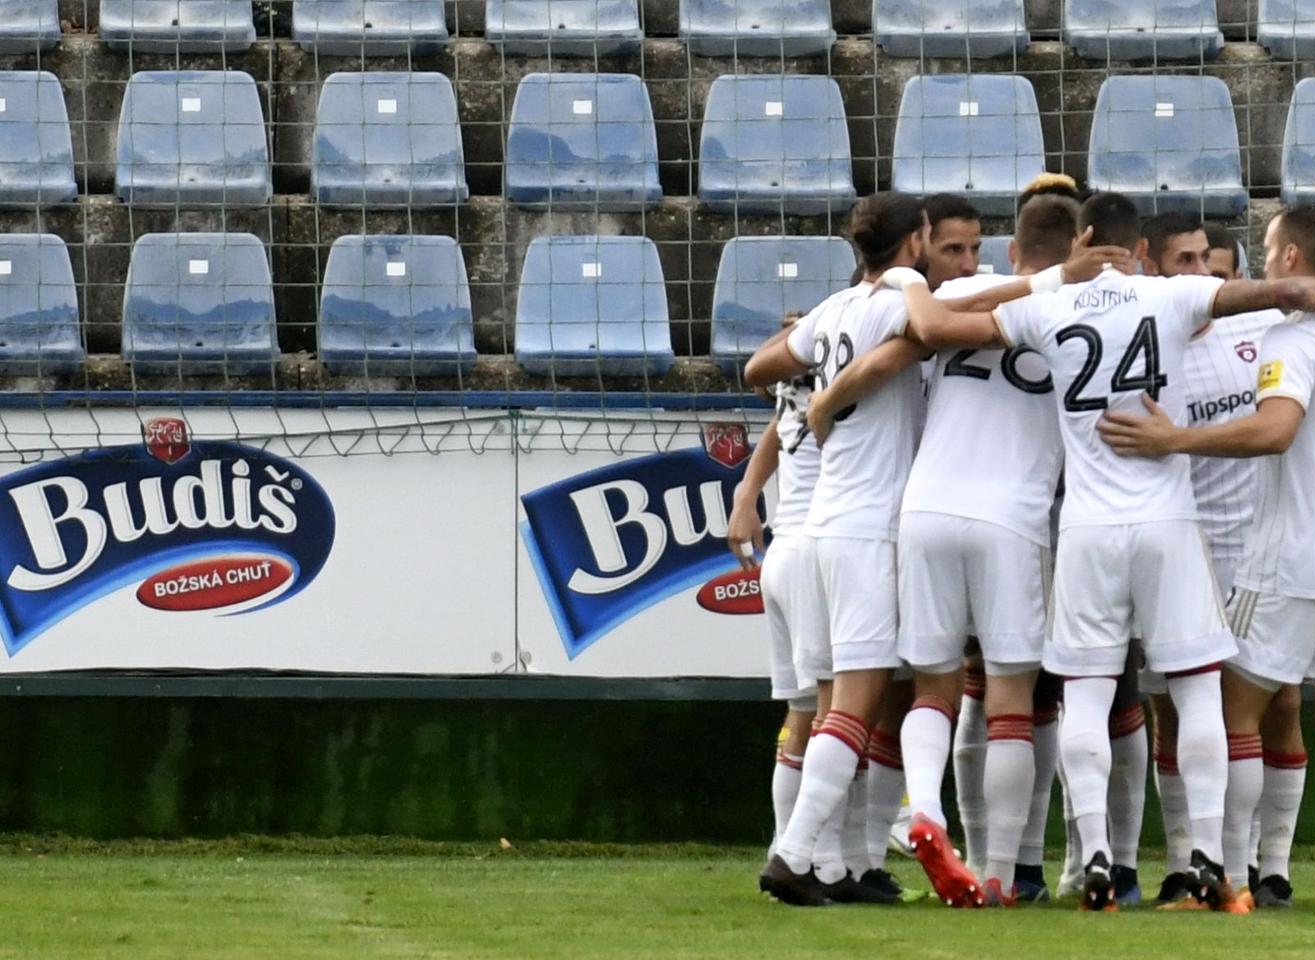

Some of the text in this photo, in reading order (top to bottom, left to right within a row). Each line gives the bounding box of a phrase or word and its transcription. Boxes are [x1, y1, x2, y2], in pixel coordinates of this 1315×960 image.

[1055, 315, 1167, 412] 24
[1187, 388, 1257, 422] Tipspo
[7, 458, 298, 591] Budiš
[154, 560, 272, 597] BOŽSKÁ CHUŤ
[714, 578, 760, 600] BOŽS
